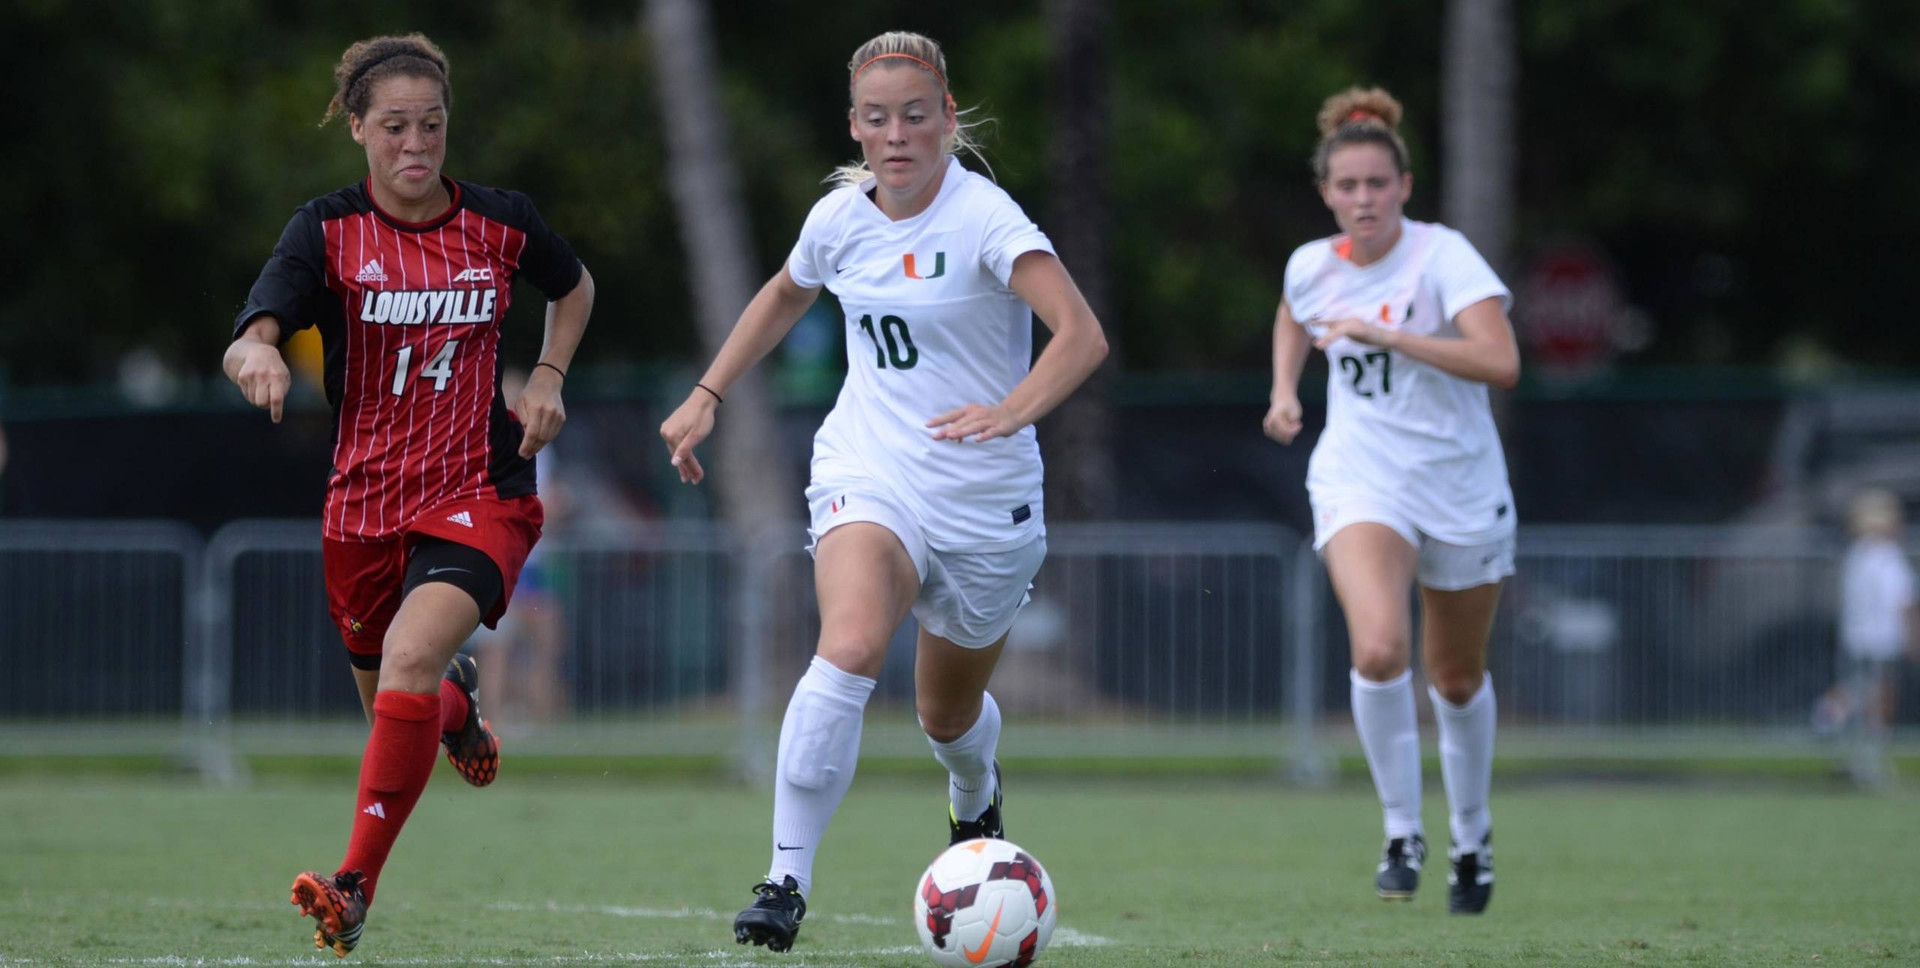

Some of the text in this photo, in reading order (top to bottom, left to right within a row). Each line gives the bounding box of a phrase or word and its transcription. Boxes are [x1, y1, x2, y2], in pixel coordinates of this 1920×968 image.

[354, 273, 389, 283] adidas
[453, 268, 491, 282] ACC
[360, 289, 497, 325] LOUISVILLE
[859, 314, 919, 371] 10
[391, 340, 460, 396] 14
[1340, 351, 1390, 397] 27
